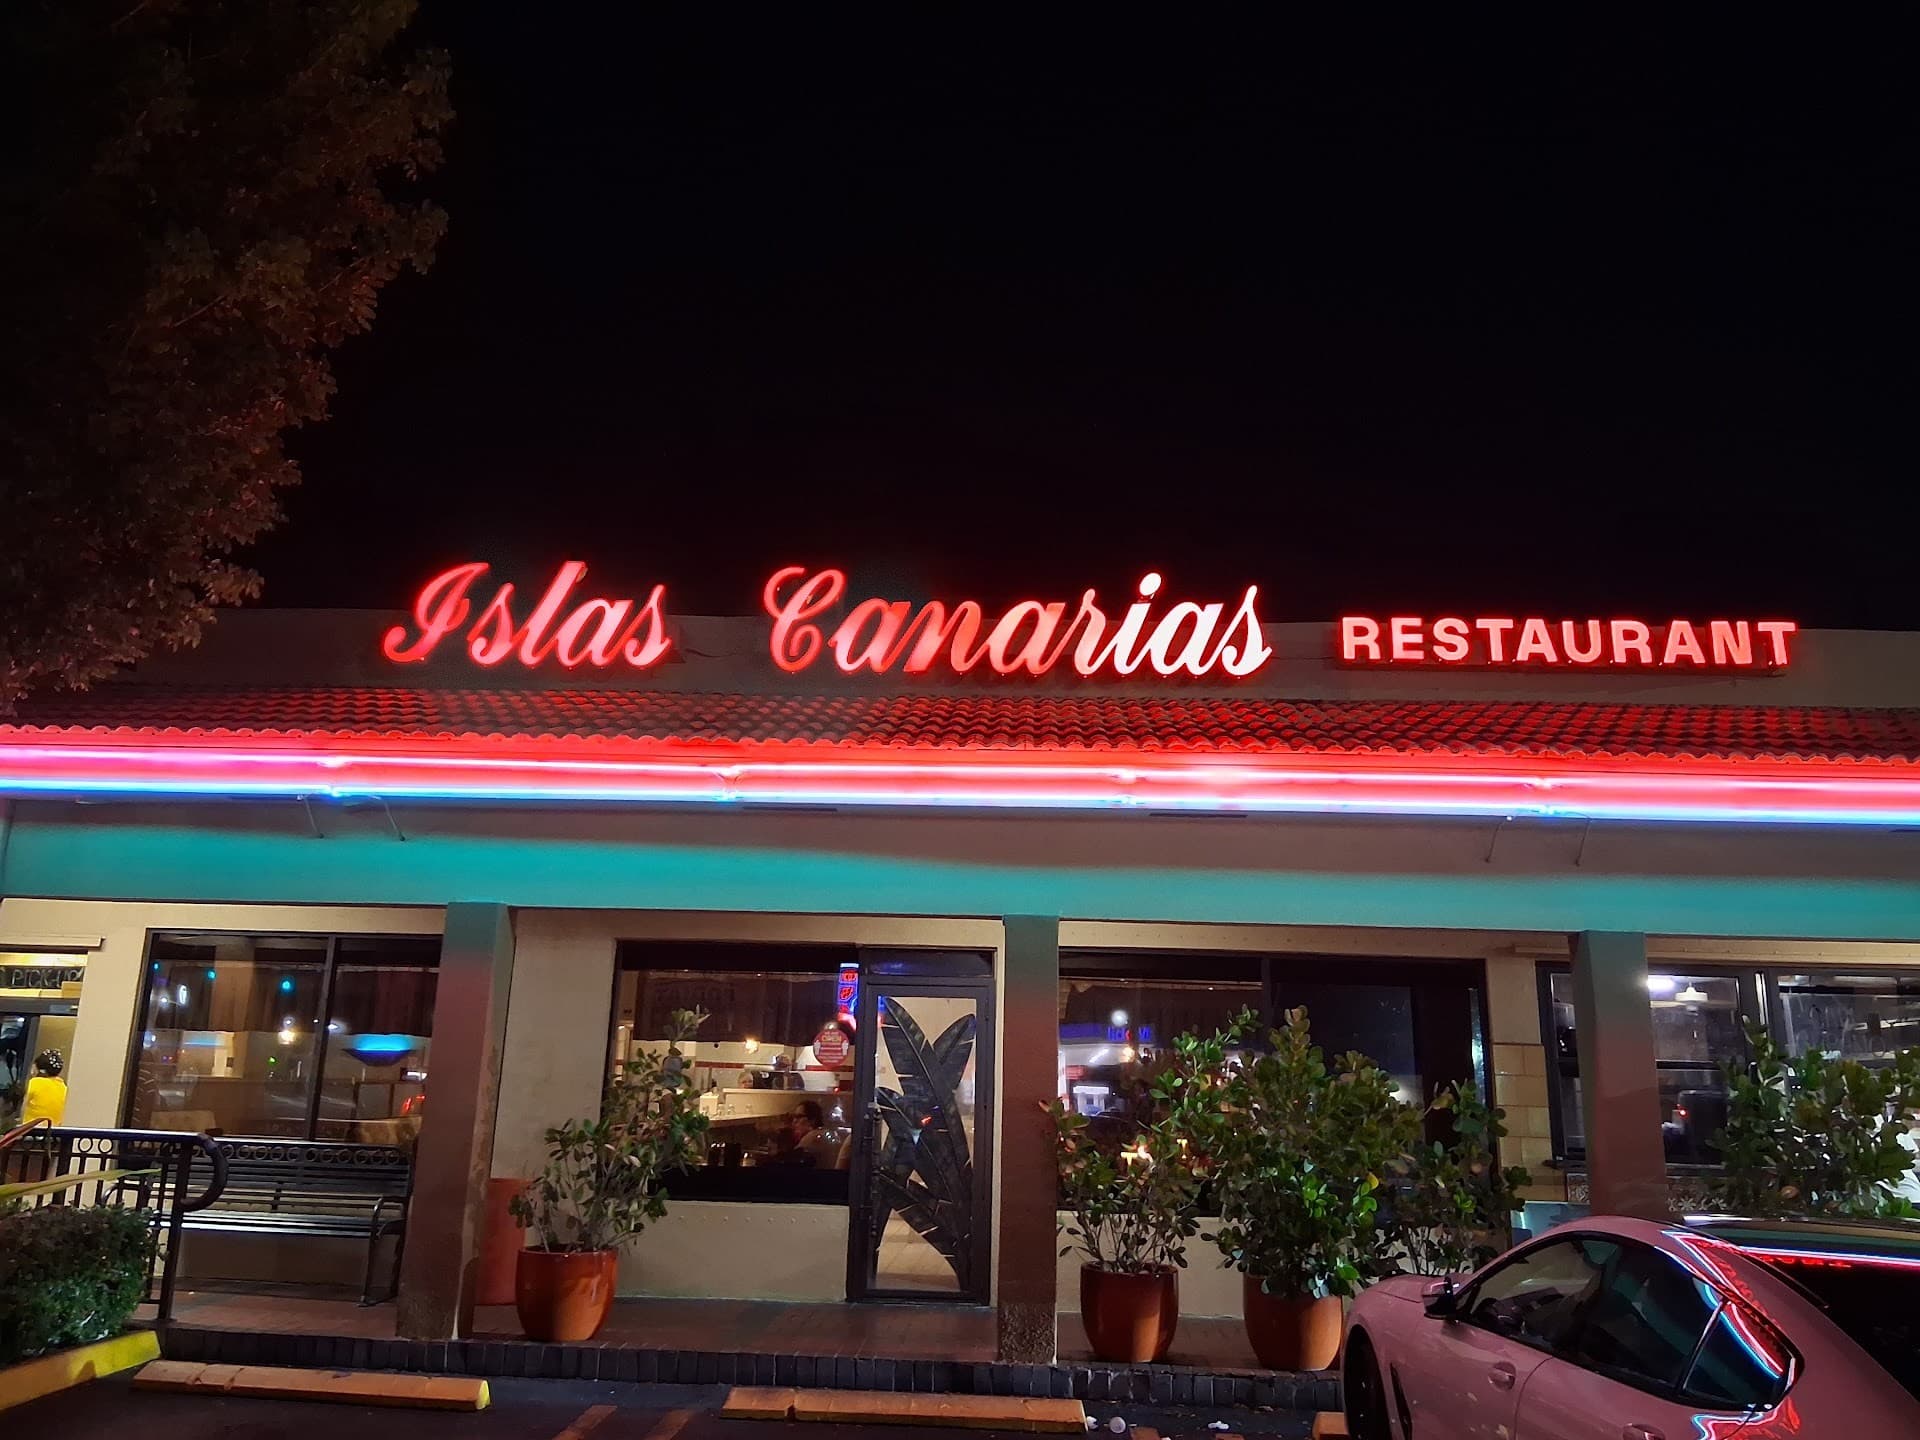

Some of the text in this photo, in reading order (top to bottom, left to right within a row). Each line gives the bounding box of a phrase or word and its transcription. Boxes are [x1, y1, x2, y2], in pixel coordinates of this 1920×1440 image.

[382, 561, 1273, 677] Islas Canarias
[1342, 616, 1796, 666] RESTAURANT
